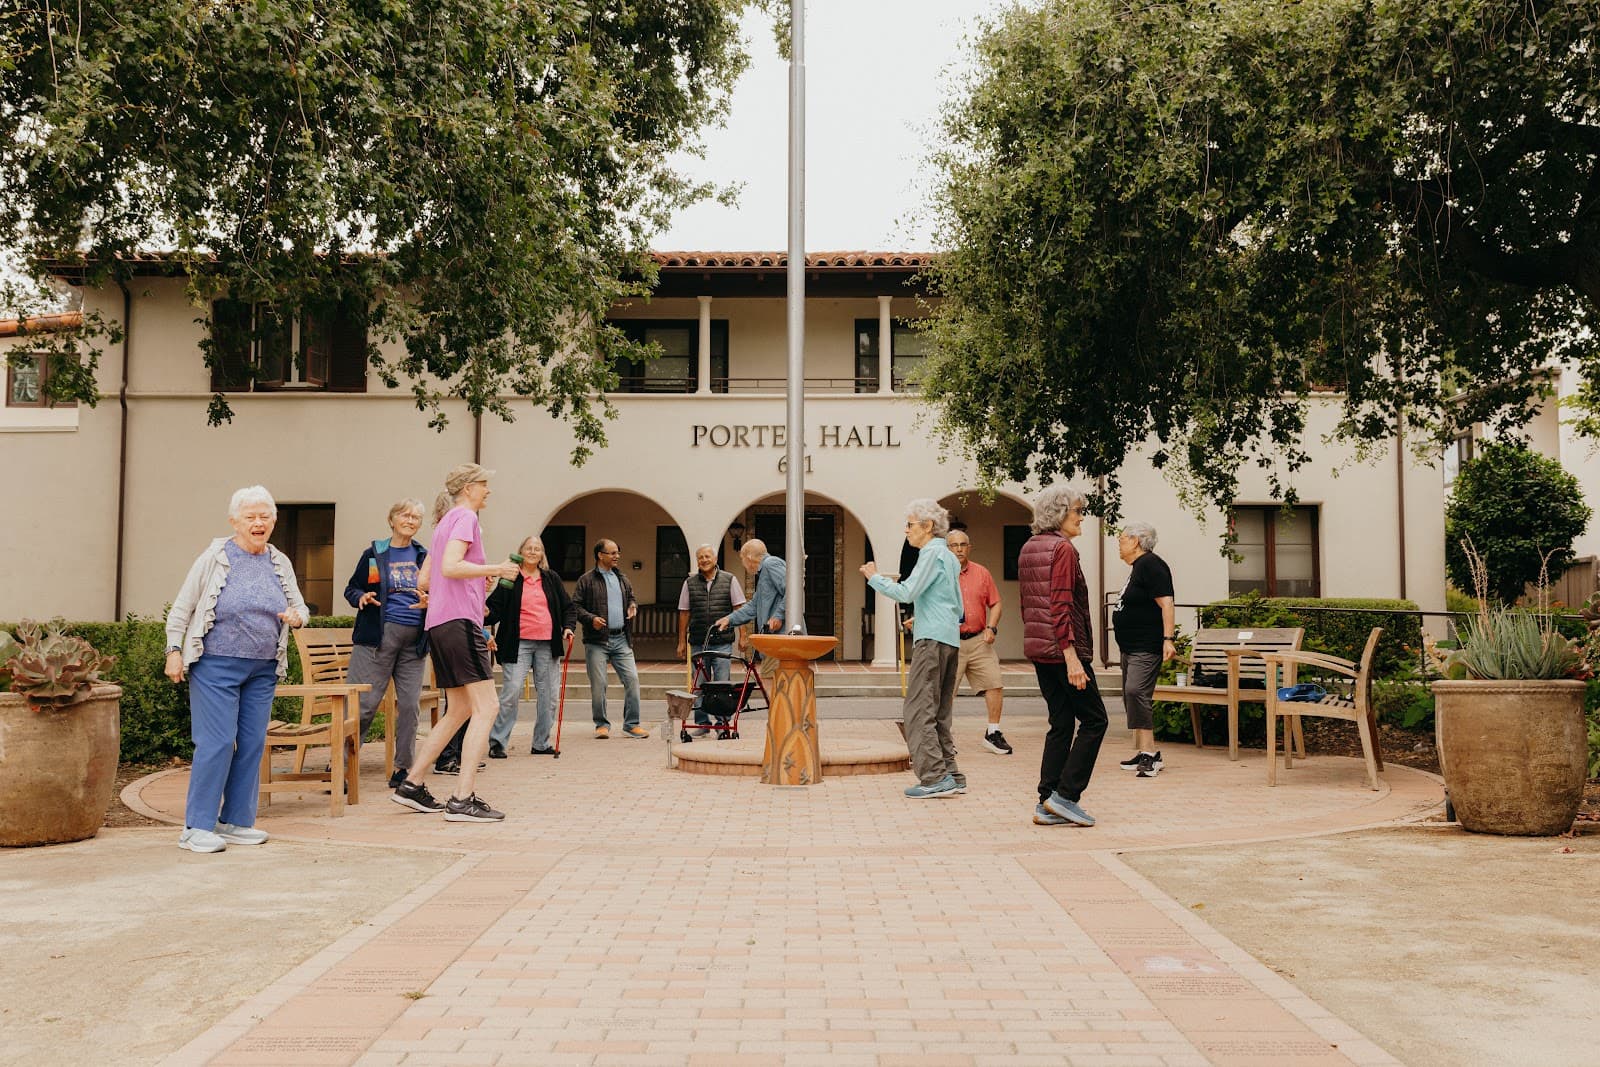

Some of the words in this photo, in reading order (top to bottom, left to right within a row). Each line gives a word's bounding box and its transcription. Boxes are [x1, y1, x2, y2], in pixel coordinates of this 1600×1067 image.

[691, 425, 807, 448] PORTE
[819, 425, 901, 448] HALL
[777, 455, 814, 473] 61
